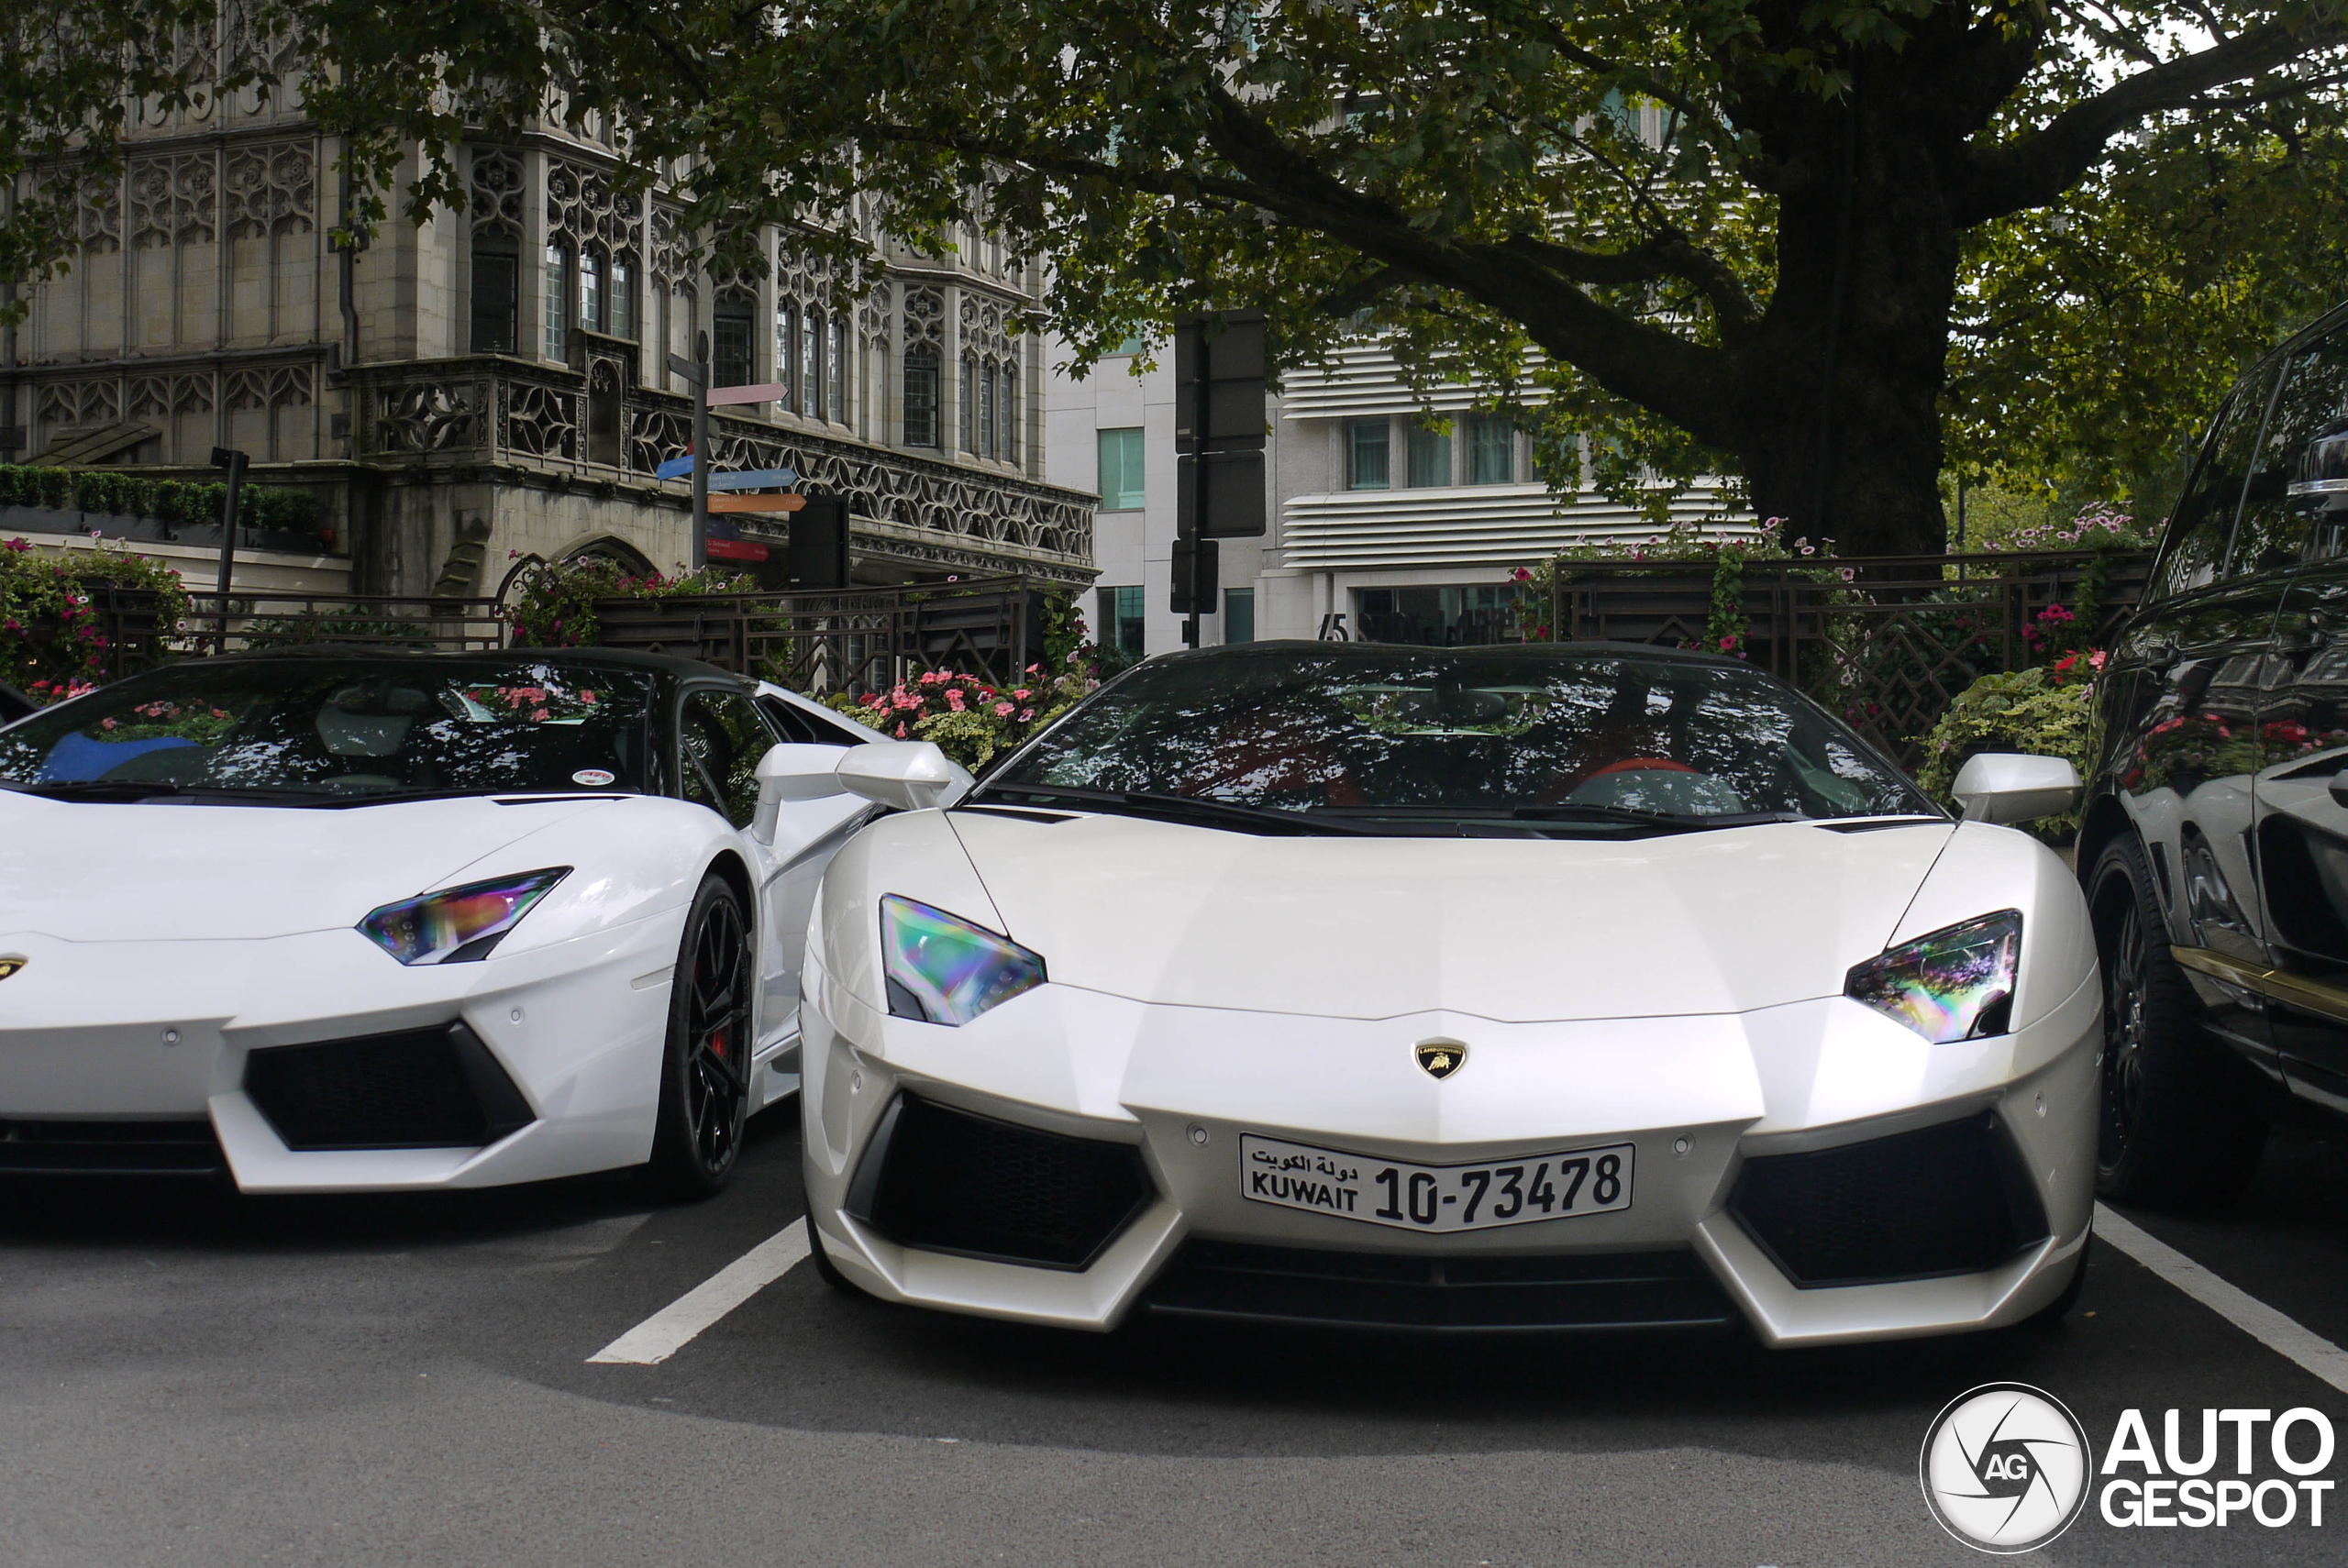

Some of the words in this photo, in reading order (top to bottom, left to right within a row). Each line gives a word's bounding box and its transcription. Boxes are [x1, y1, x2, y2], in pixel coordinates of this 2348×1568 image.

[1252, 1151, 1311, 1172] الكويت
[1316, 1156, 1358, 1182] دولة
[1252, 1171, 1358, 1211] KUWAIT
[1376, 1154, 1621, 1225] 10-73478
